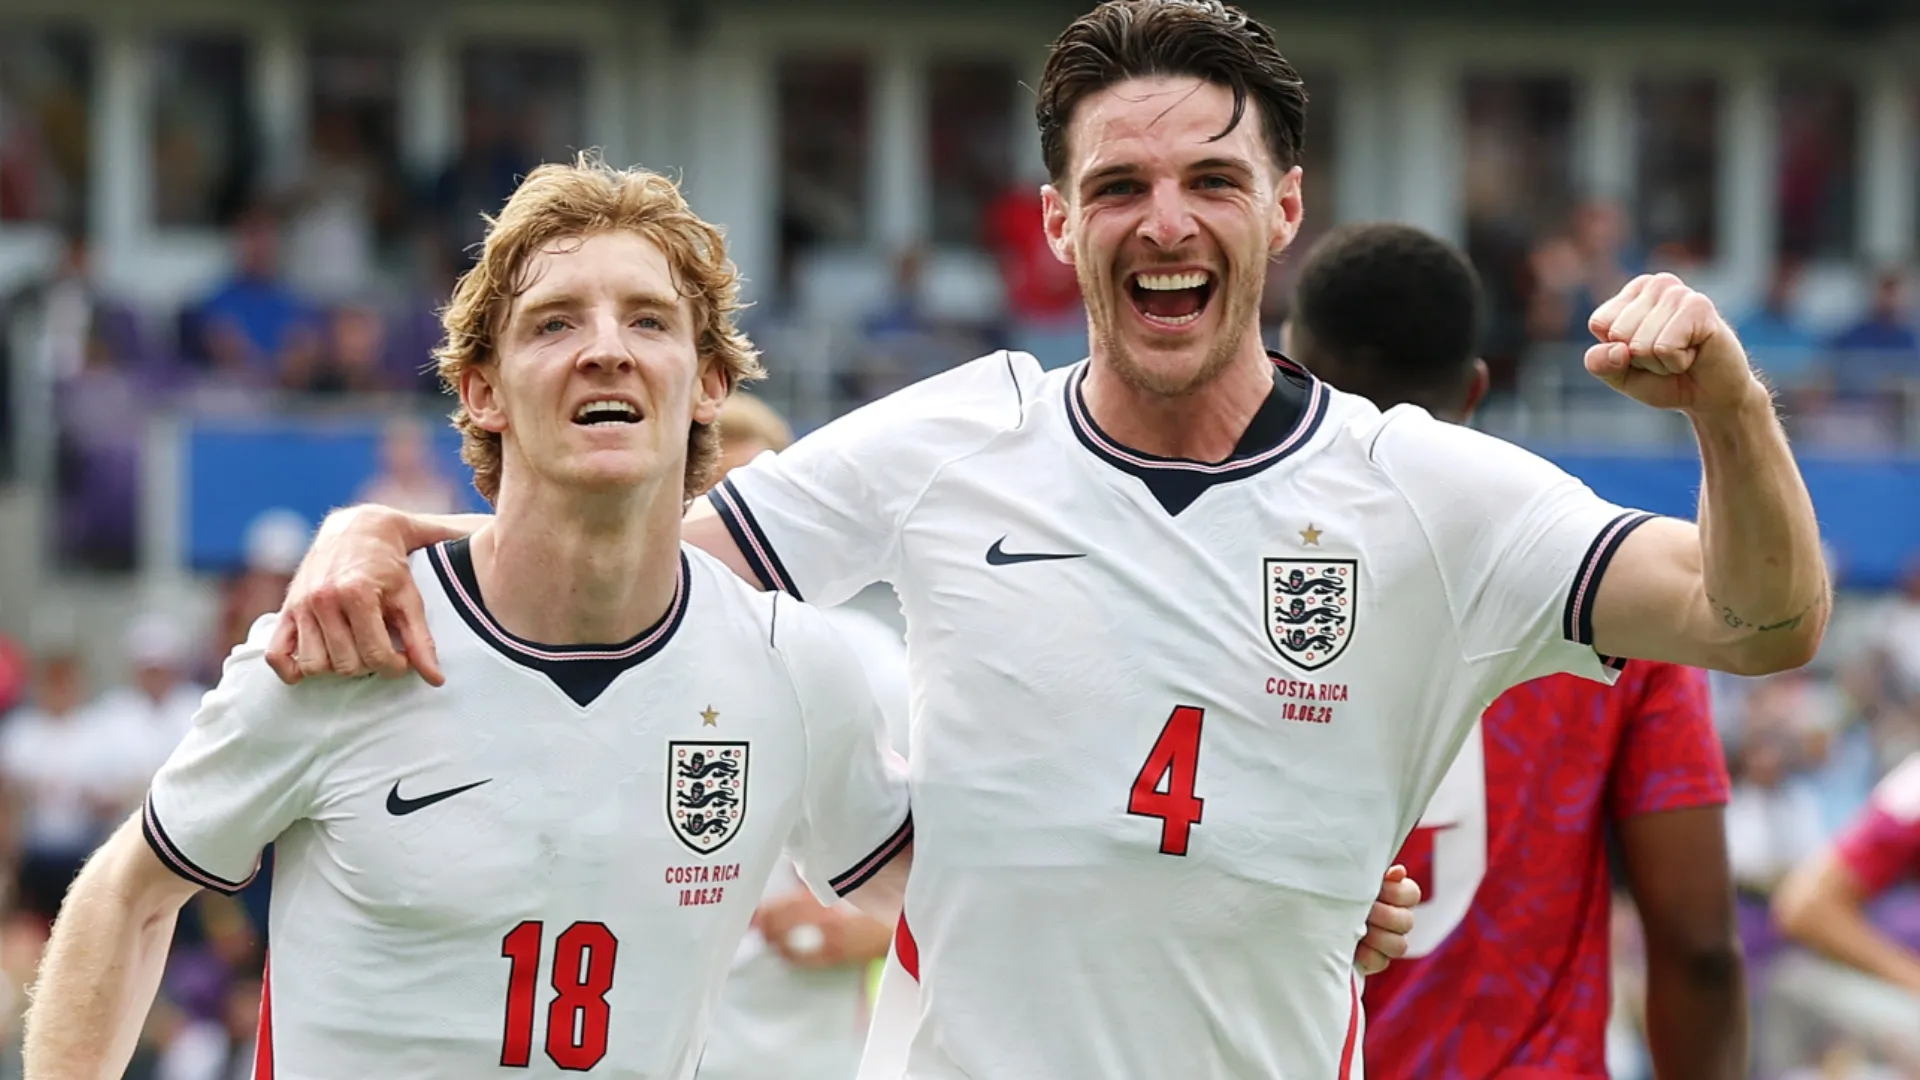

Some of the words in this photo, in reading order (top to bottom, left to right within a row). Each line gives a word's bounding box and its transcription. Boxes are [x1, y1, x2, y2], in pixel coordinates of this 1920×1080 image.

[1266, 677, 1315, 700] COSTA
[1319, 683, 1348, 701] RICA
[1282, 703, 1332, 723] 10.06.26
[1127, 704, 1204, 856] 4
[665, 866, 708, 883] COSTA
[712, 863, 740, 882] RICA
[679, 887, 723, 906] 10.06.26
[499, 920, 618, 1071] 18
